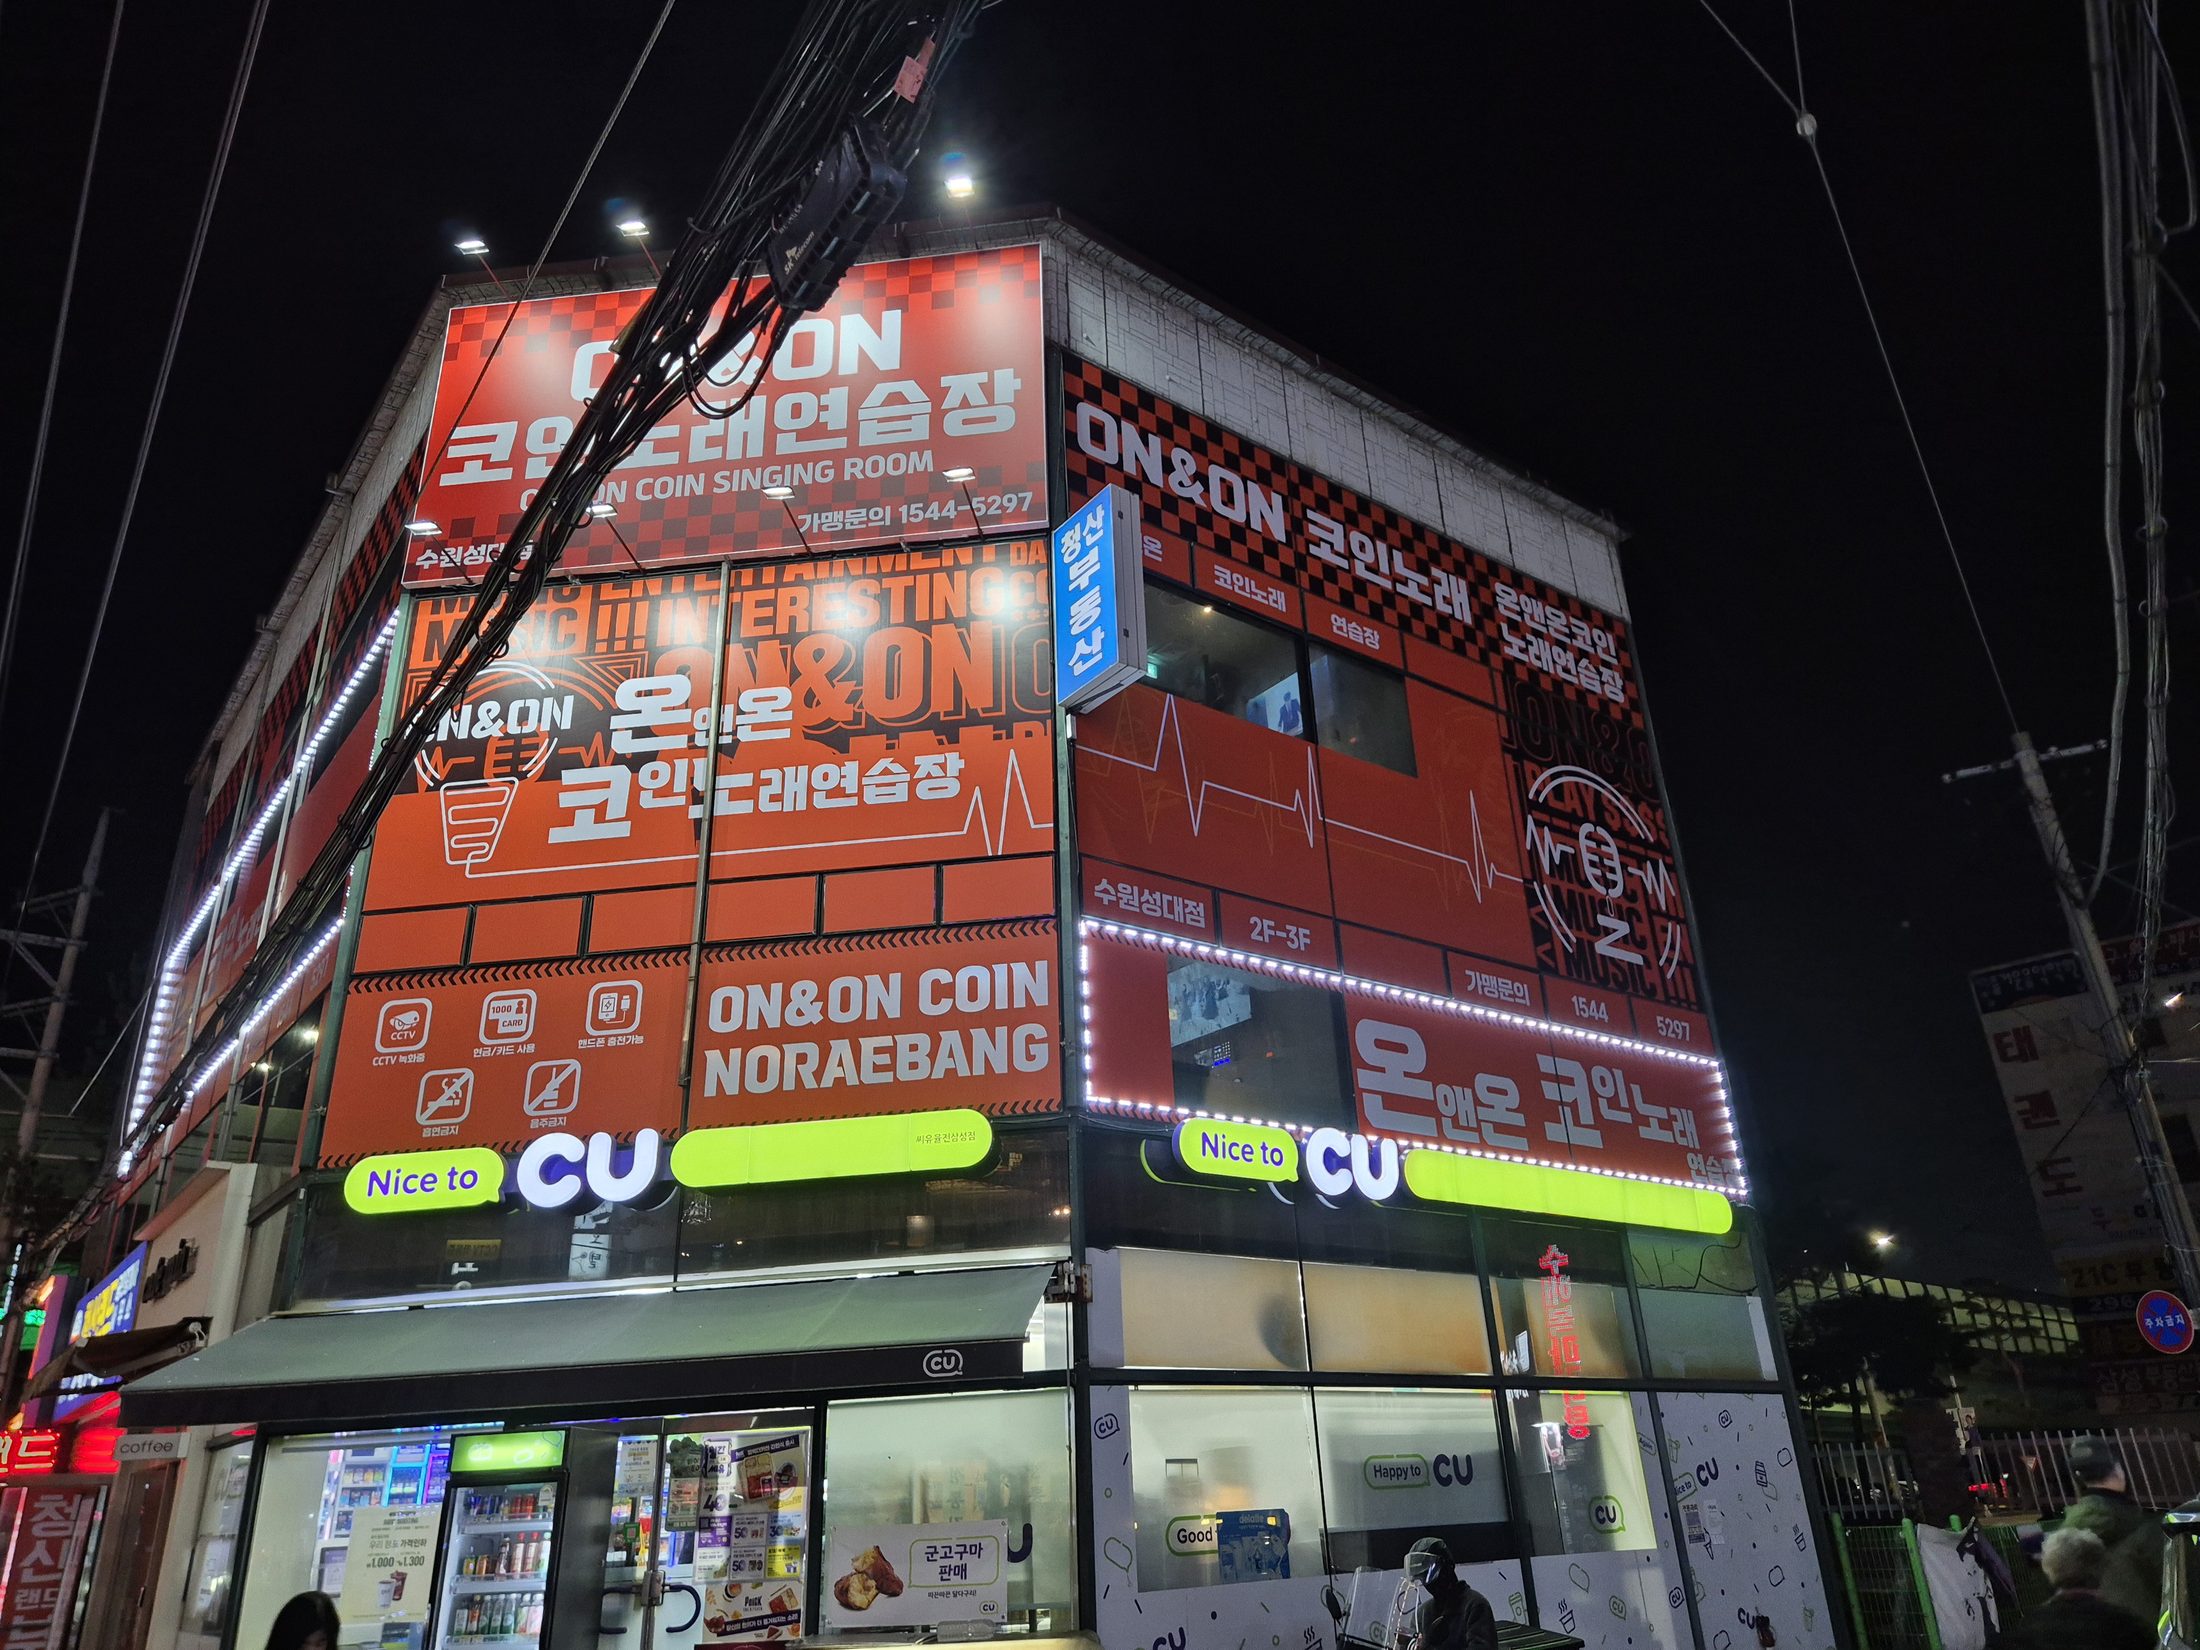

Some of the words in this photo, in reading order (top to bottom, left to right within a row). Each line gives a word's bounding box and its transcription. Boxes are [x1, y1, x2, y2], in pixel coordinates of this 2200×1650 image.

[635, 472, 705, 501] COIN
[713, 459, 835, 494] SINGING
[844, 449, 934, 482] ROOM
[798, 506, 891, 533] 가맹문의
[898, 491, 1034, 525] 1544-5297
[1075, 401, 1285, 544] ON&ON
[1304, 507, 1473, 625] 코인노래
[1068, 545, 1106, 676] 부동산
[1213, 564, 1287, 613] 코인노래
[1330, 613, 1381, 651] 연습장
[1494, 581, 1619, 666] 온앤온코인
[1500, 622, 1625, 704] 노래연습장
[547, 751, 966, 845] 코인노래연습장
[1094, 878, 1206, 928] 수원성대점
[1249, 915, 1311, 951] 2F-3F
[491, 1003, 512, 1014] 1000
[707, 971, 901, 1034] ON&ON
[919, 959, 1049, 1016] COIN
[1464, 969, 1530, 1007] 가맹문의
[1571, 994, 1609, 1023] 1544
[1656, 1014, 1691, 1042] 5297
[391, 1030, 416, 1041] CCTV
[502, 1018, 524, 1028] CARD
[372, 1054, 397, 1067] CCTV
[704, 1022, 1049, 1098] NORAEBANG
[1355, 1018, 1530, 1151] 온앤온
[1536, 1052, 1701, 1150] 코인노래
[367, 1167, 439, 1198] Nice
[448, 1166, 479, 1191] to
[516, 1127, 661, 1209] CU
[1200, 1133, 1254, 1163] Nice
[1261, 1138, 1285, 1167] to
[1305, 1127, 1399, 1200] CU
[2144, 1313, 2185, 1329] 주차금지
[930, 1356, 956, 1371] CU
[1099, 1418, 1114, 1433] CU
[119, 1438, 174, 1455] coffee
[1373, 1463, 1408, 1480] Happy
[1409, 1465, 1422, 1477] to
[1433, 1453, 1474, 1487] CU
[1696, 1457, 1720, 1487] CU
[1595, 1505, 1617, 1525] CU
[924, 1542, 984, 1562] 군고구마
[1176, 1527, 1213, 1544] Good
[938, 1562, 968, 1582] 판매
[982, 1604, 995, 1612] CU
